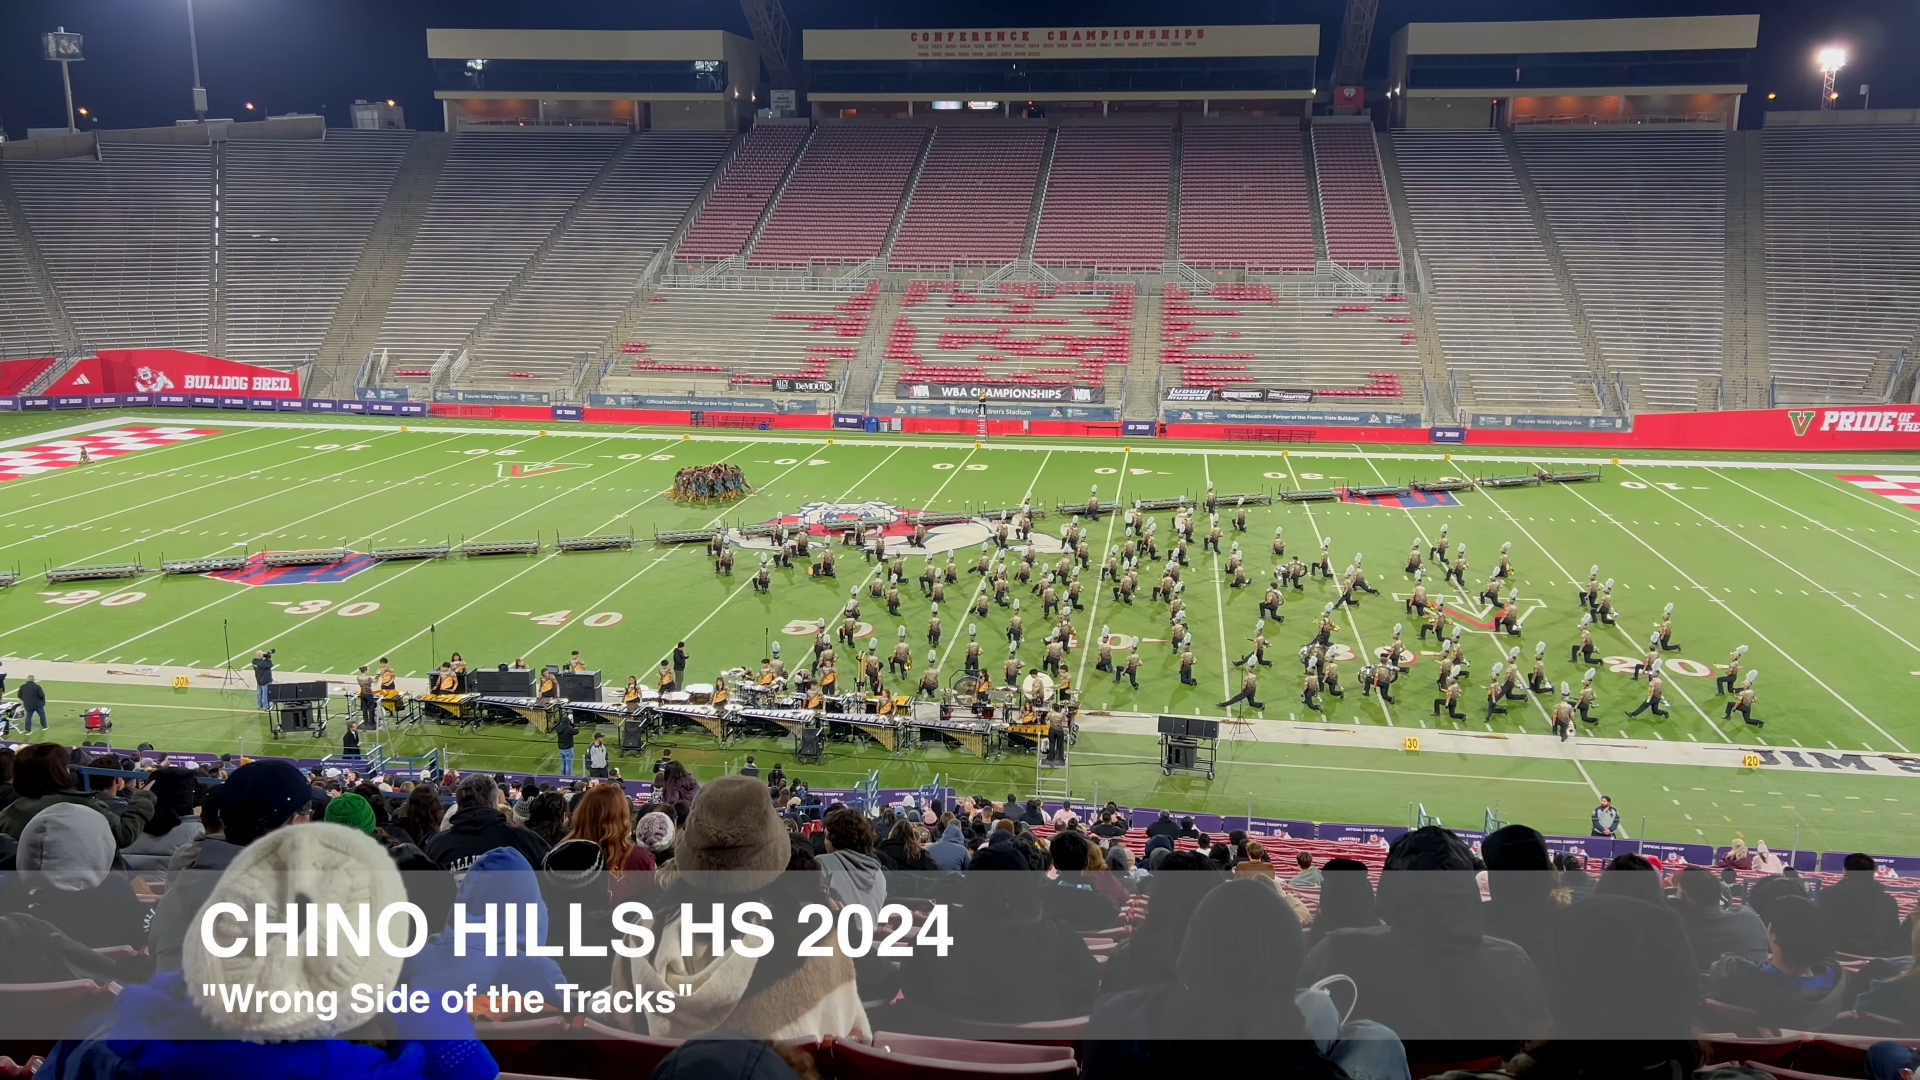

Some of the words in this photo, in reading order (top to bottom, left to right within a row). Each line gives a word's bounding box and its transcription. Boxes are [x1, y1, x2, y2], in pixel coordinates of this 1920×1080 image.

[910, 31, 1030, 42] CONFERENCE
[1047, 28, 1205, 41] CHAMPIONSHIPS
[184, 375, 249, 390] BULLDOG
[252, 377, 292, 391] BRED.
[942, 387, 967, 397] WBA
[957, 407, 974, 415] Valley
[1820, 411, 1898, 432] PRIDE
[1898, 412, 1915, 423] OF
[1788, 411, 1816, 437] V
[1897, 422, 1920, 433] THE
[173, 677, 185, 687] 30
[1407, 738, 1418, 749] 30
[1747, 755, 1759, 767] 20
